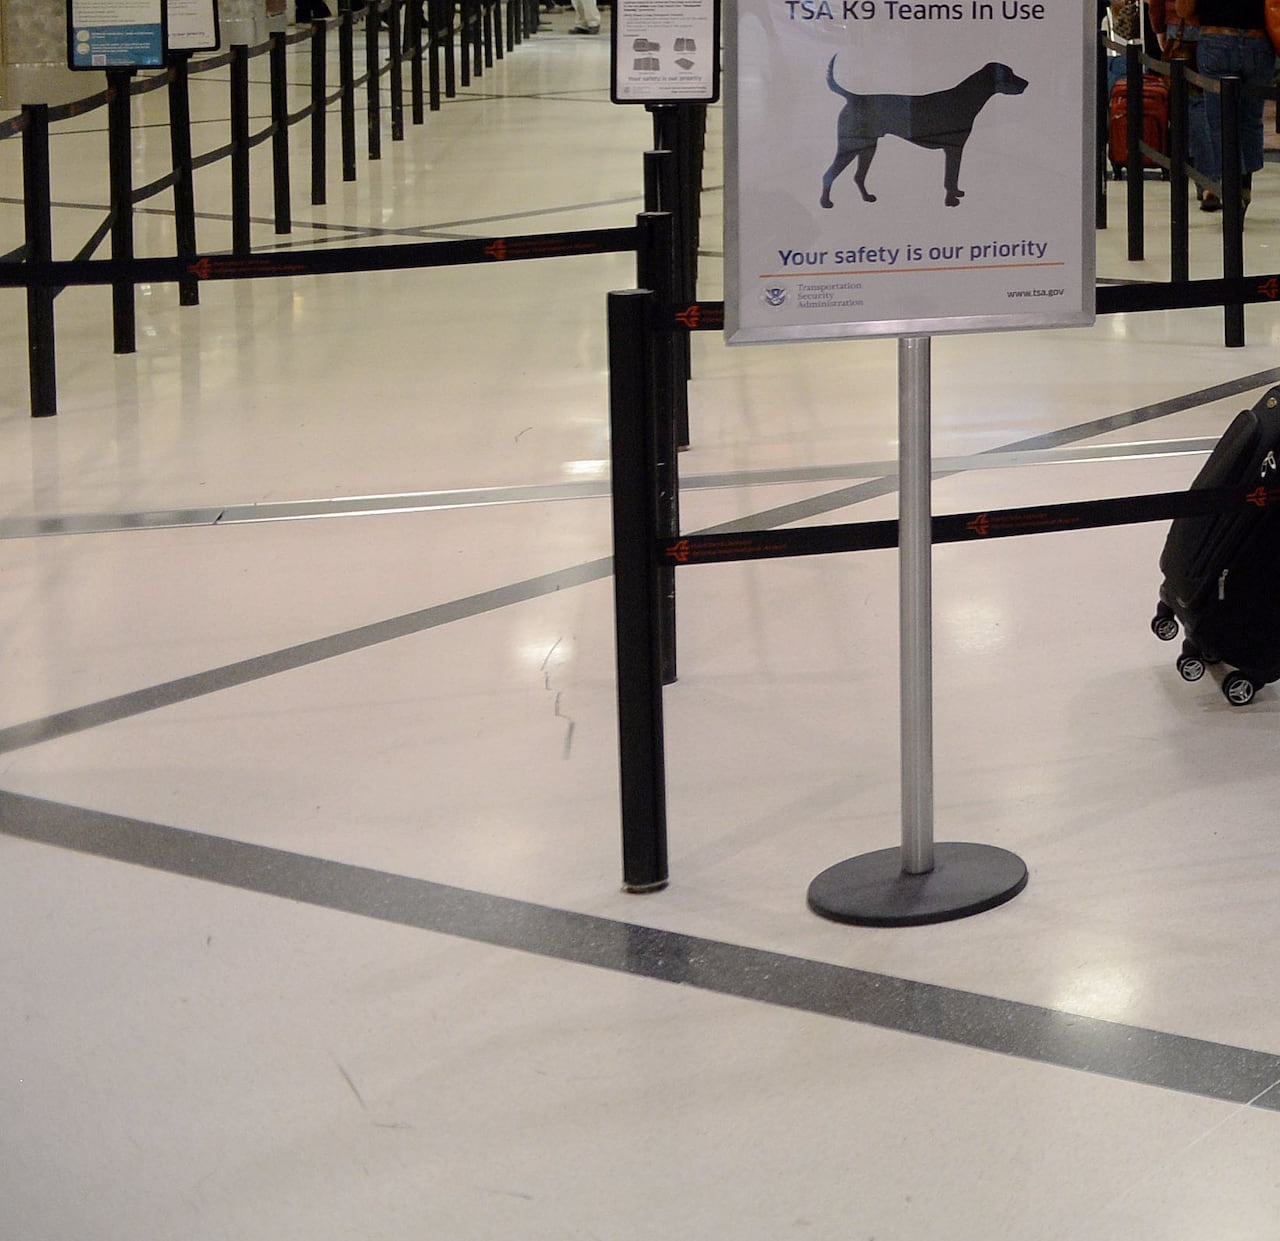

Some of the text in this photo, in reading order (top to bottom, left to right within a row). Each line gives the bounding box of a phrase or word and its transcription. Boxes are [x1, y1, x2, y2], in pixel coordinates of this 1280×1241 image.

[785, 0, 1045, 20] TSA K9 Teams In Use
[778, 240, 1047, 266] Your safety is our priority
[797, 282, 862, 291] Transportation
[797, 287, 1065, 301] Security www.tsa.gov
[797, 299, 864, 308] Administration
